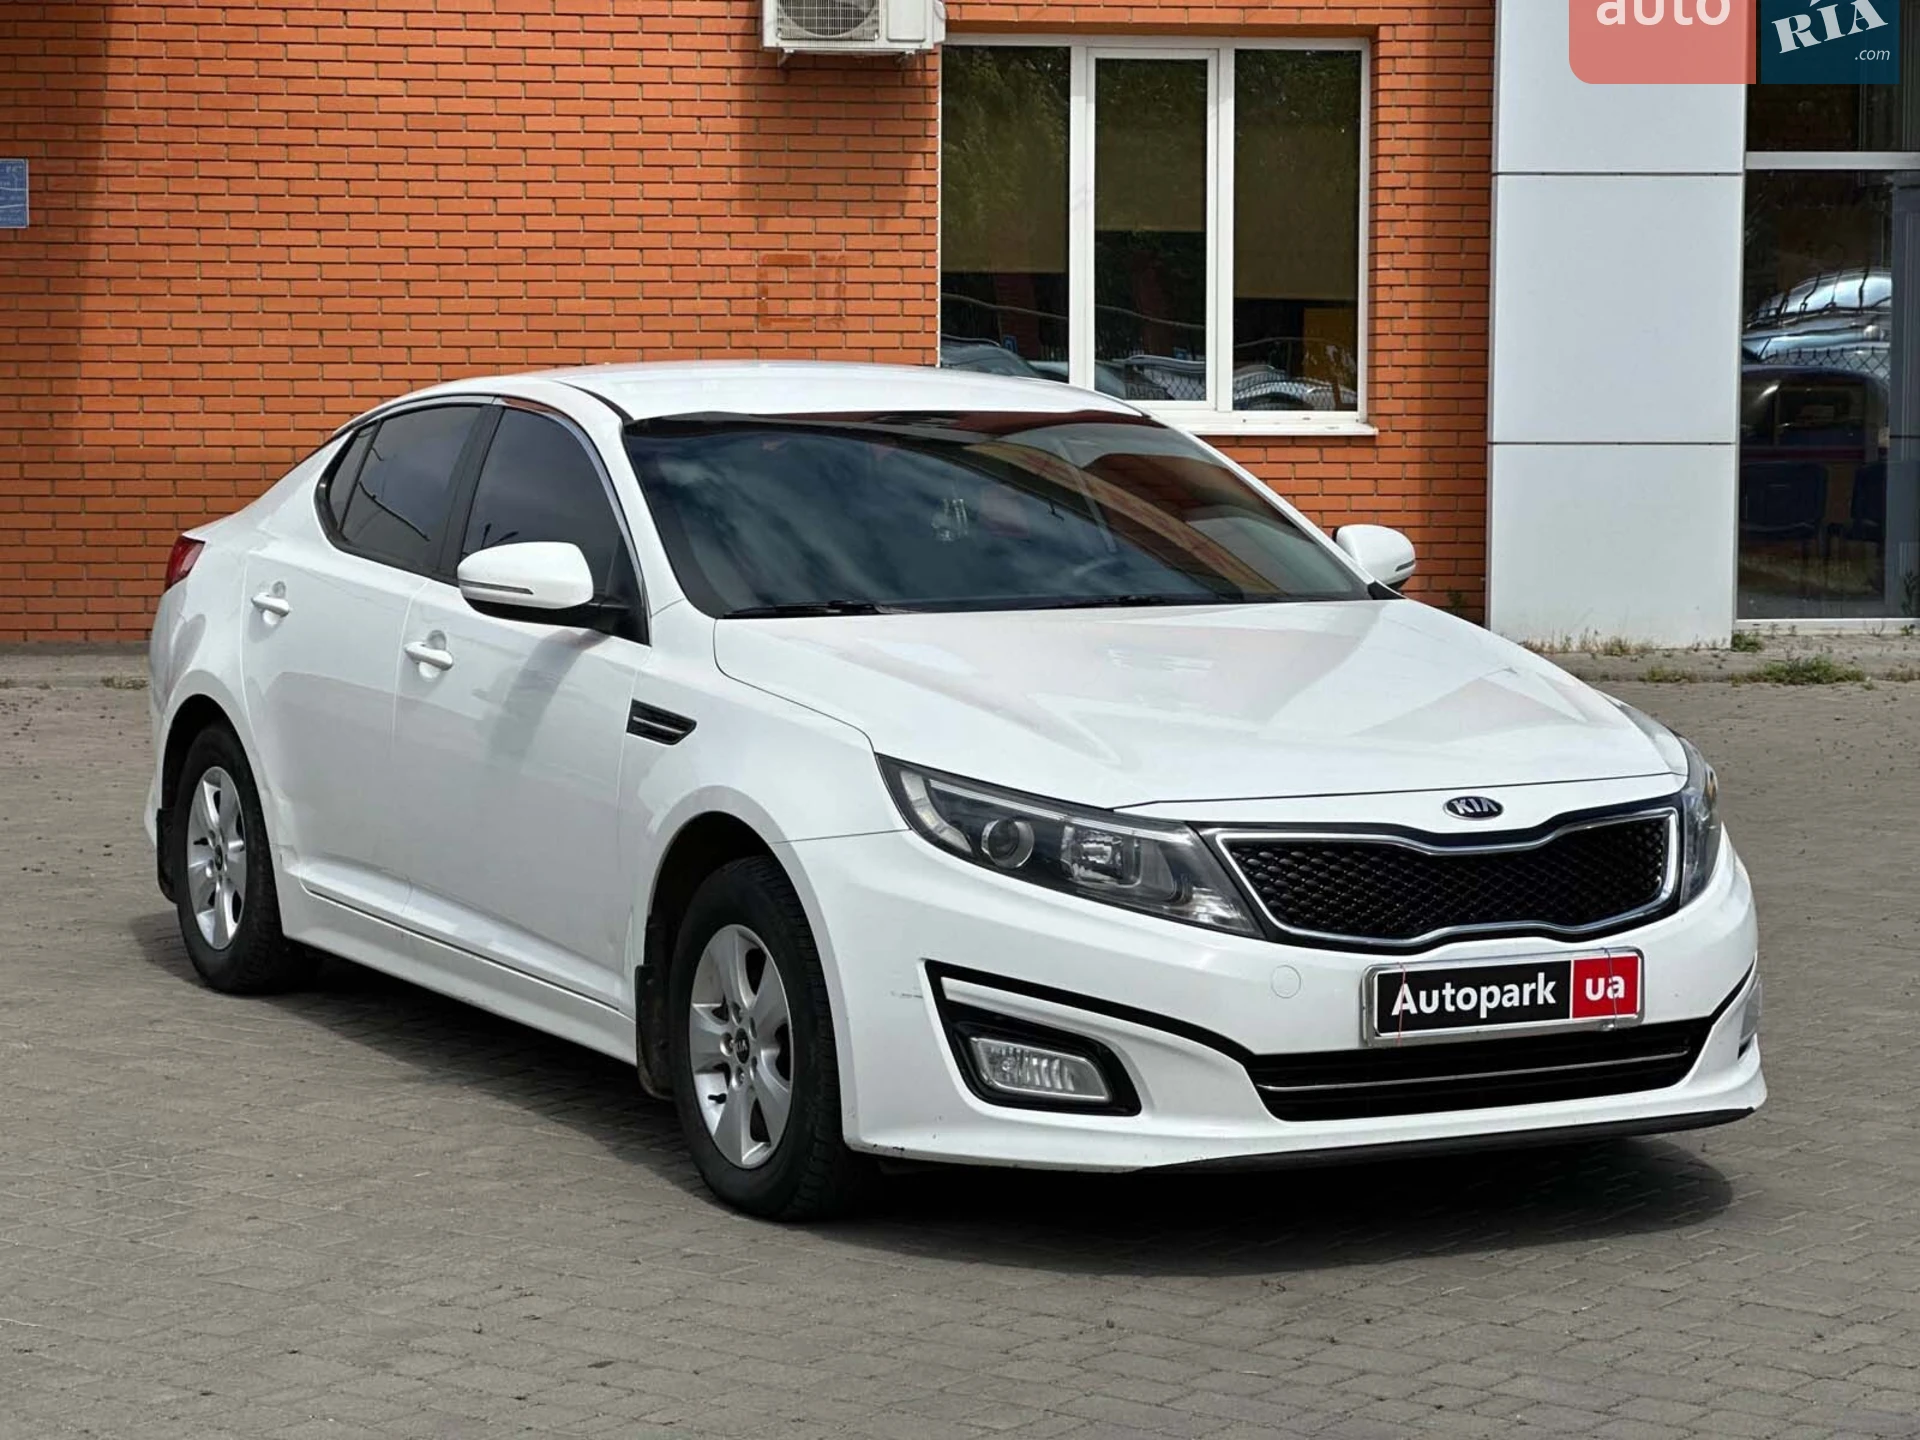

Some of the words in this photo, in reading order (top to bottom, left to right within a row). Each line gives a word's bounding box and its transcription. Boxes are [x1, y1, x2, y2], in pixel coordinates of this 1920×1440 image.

[1451, 798, 1499, 815] KIA
[1391, 972, 1556, 1019] Autopark
[1585, 975, 1625, 1001] ua
